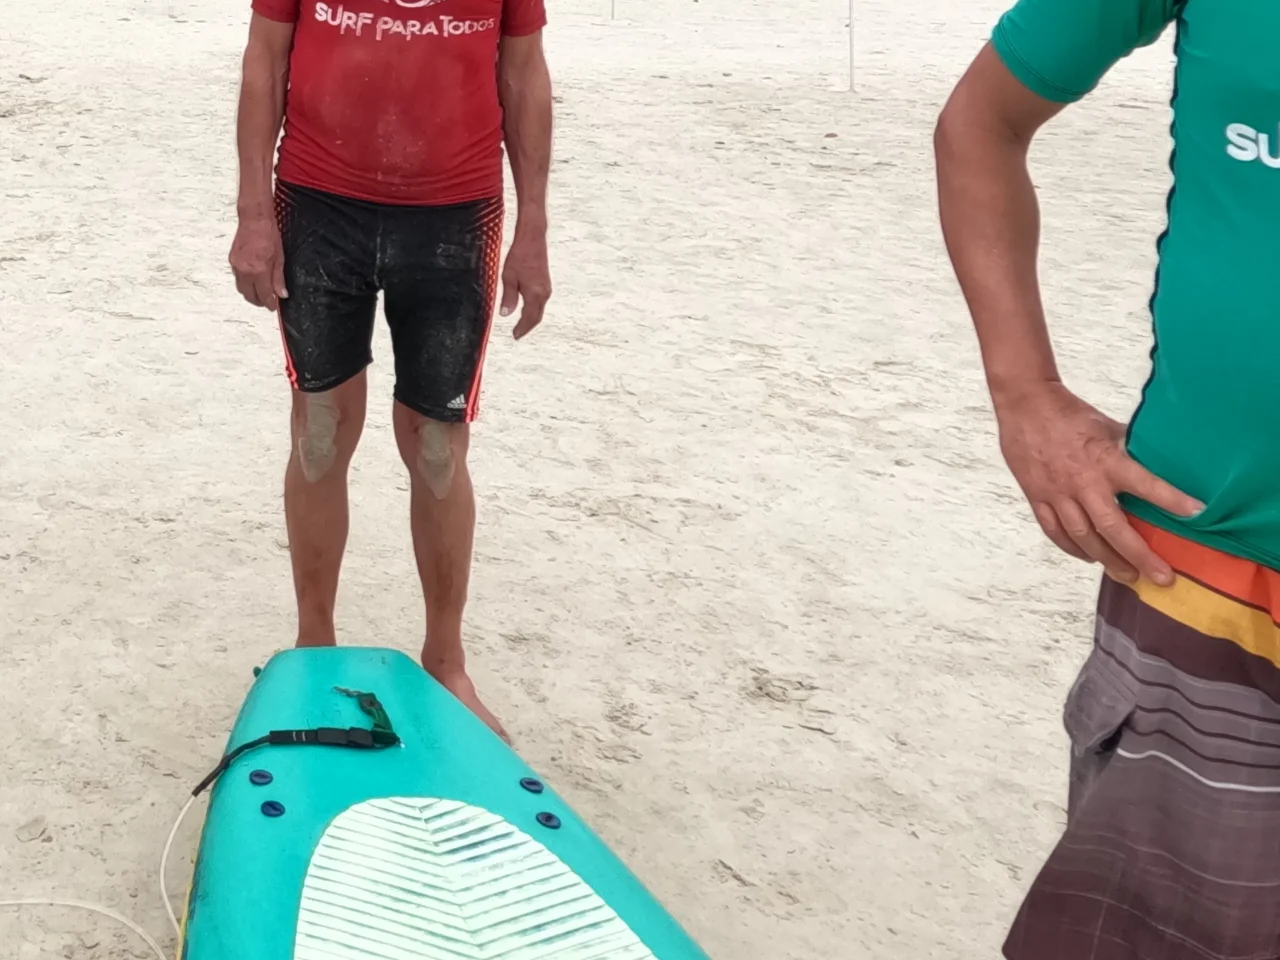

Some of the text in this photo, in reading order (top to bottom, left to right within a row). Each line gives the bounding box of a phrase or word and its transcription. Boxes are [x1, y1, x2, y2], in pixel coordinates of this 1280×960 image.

[314, 2, 495, 41] SURF PARA TODOS
